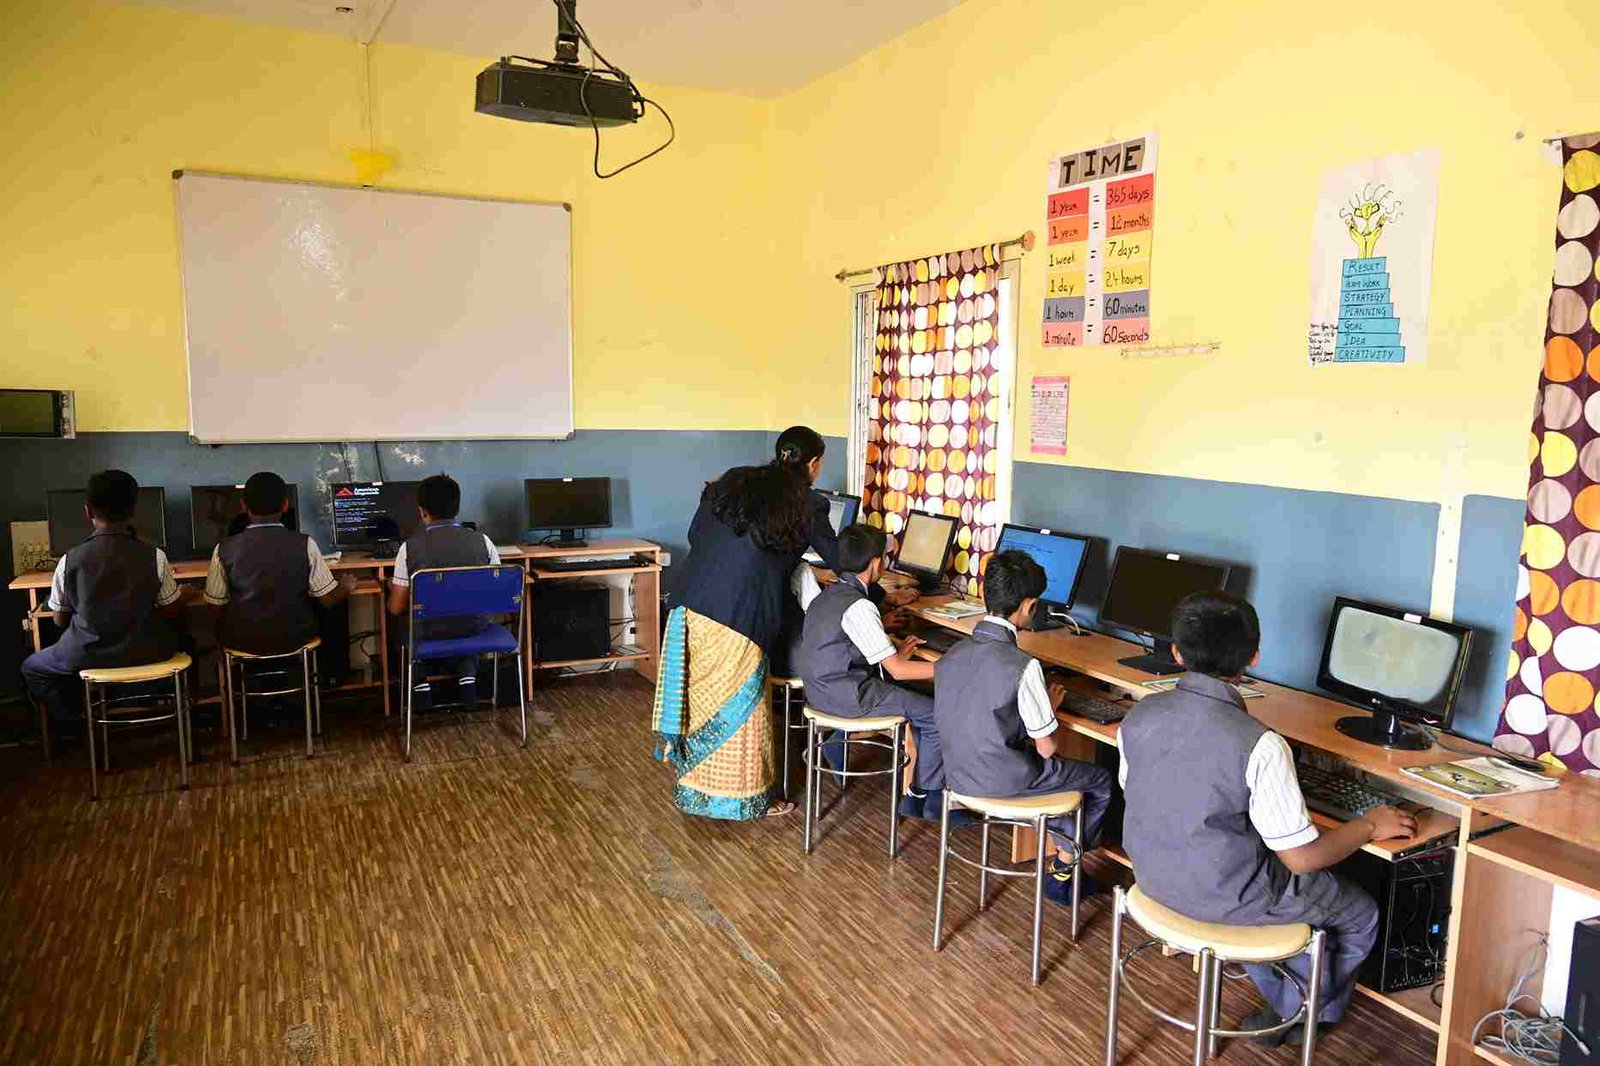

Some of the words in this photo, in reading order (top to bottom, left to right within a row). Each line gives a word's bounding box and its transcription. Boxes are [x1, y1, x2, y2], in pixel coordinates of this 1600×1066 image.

[1063, 144, 1141, 184] TIME
[1051, 199, 1057, 214] 1
[1106, 186, 1126, 206] 365
[1128, 185, 1150, 203] days
[1052, 225, 1058, 239] 1
[1111, 214, 1122, 231] 12
[1123, 212, 1150, 229] months
[1049, 253, 1054, 267] 1
[1108, 241, 1117, 258] 7
[1117, 239, 1140, 260] days
[1050, 279, 1055, 293] 1
[1057, 277, 1075, 295] day
[1105, 271, 1119, 288] 24
[1120, 268, 1143, 286] hours
[1046, 305, 1051, 320] 1
[1105, 297, 1120, 317] 60
[1120, 303, 1146, 315] minutes
[1344, 305, 1387, 317] PLANNING
[1044, 330, 1050, 344] 1
[1051, 332, 1076, 345] minute
[1103, 325, 1118, 344] 60
